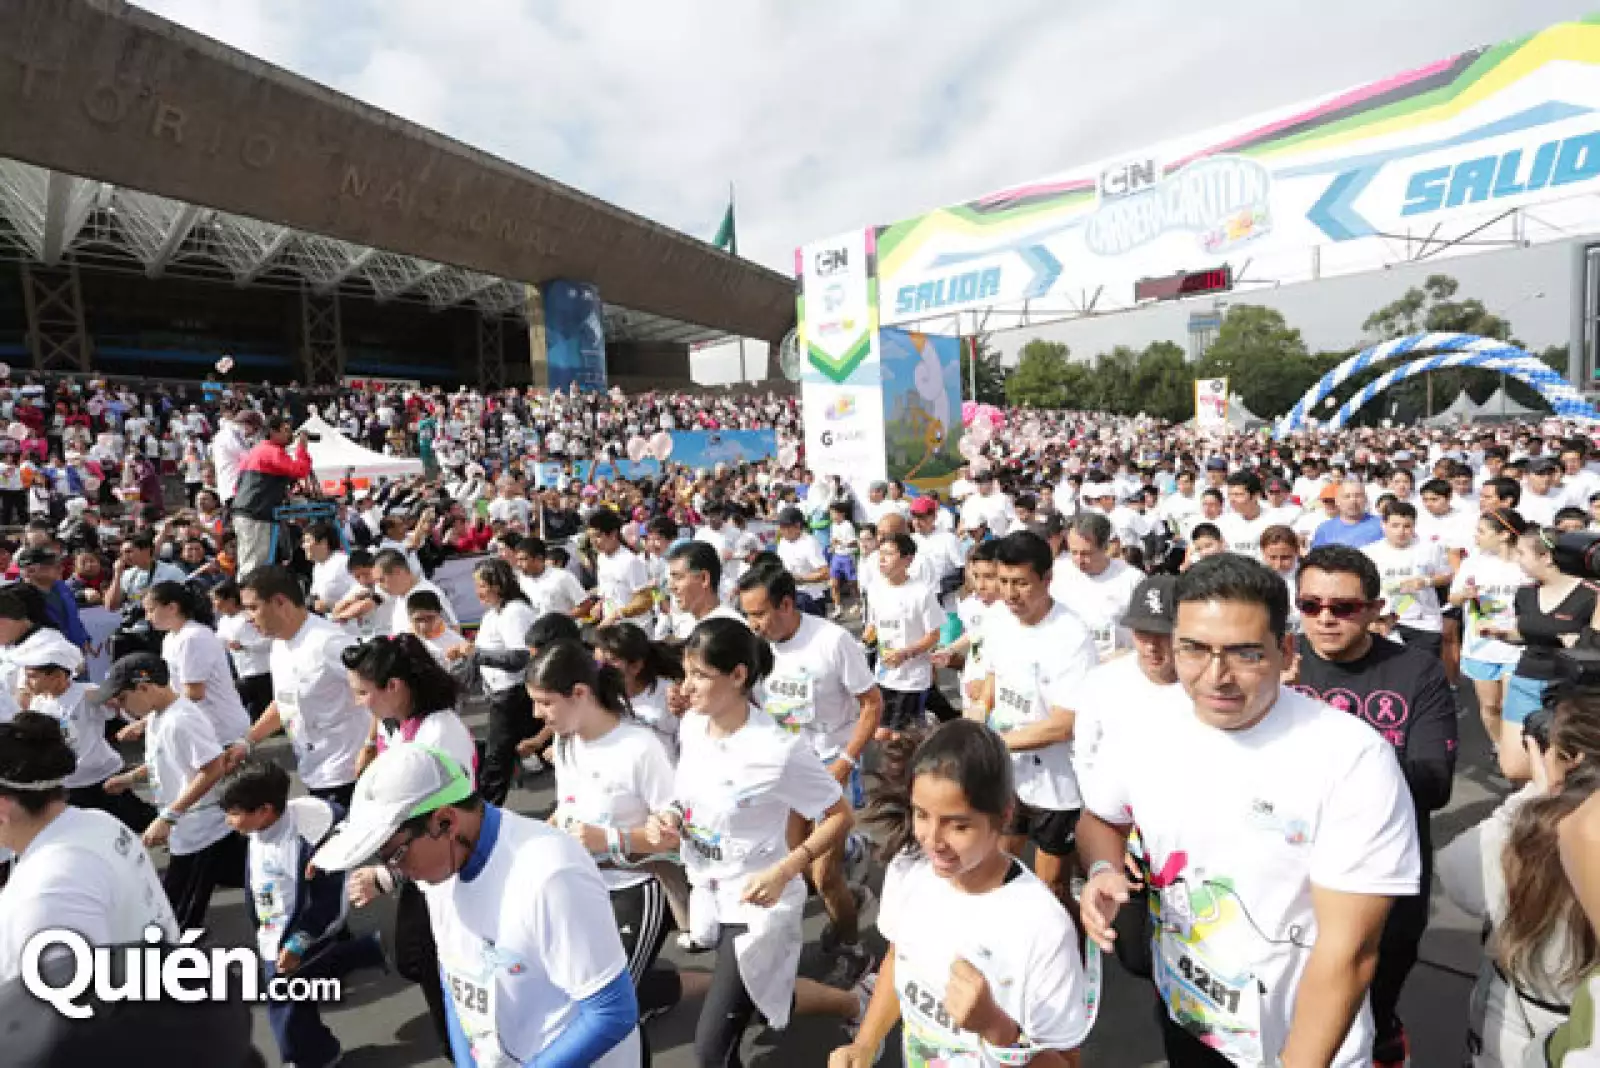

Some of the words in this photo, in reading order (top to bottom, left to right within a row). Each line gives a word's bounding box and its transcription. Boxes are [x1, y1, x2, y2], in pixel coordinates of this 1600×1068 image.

[1101, 159, 1156, 196] CN
[1401, 131, 1600, 214] SALID
[896, 265, 1001, 313] SALIDA
[447, 973, 488, 1014] 529
[905, 981, 960, 1036] 428
[1178, 954, 1241, 1014] 4281
